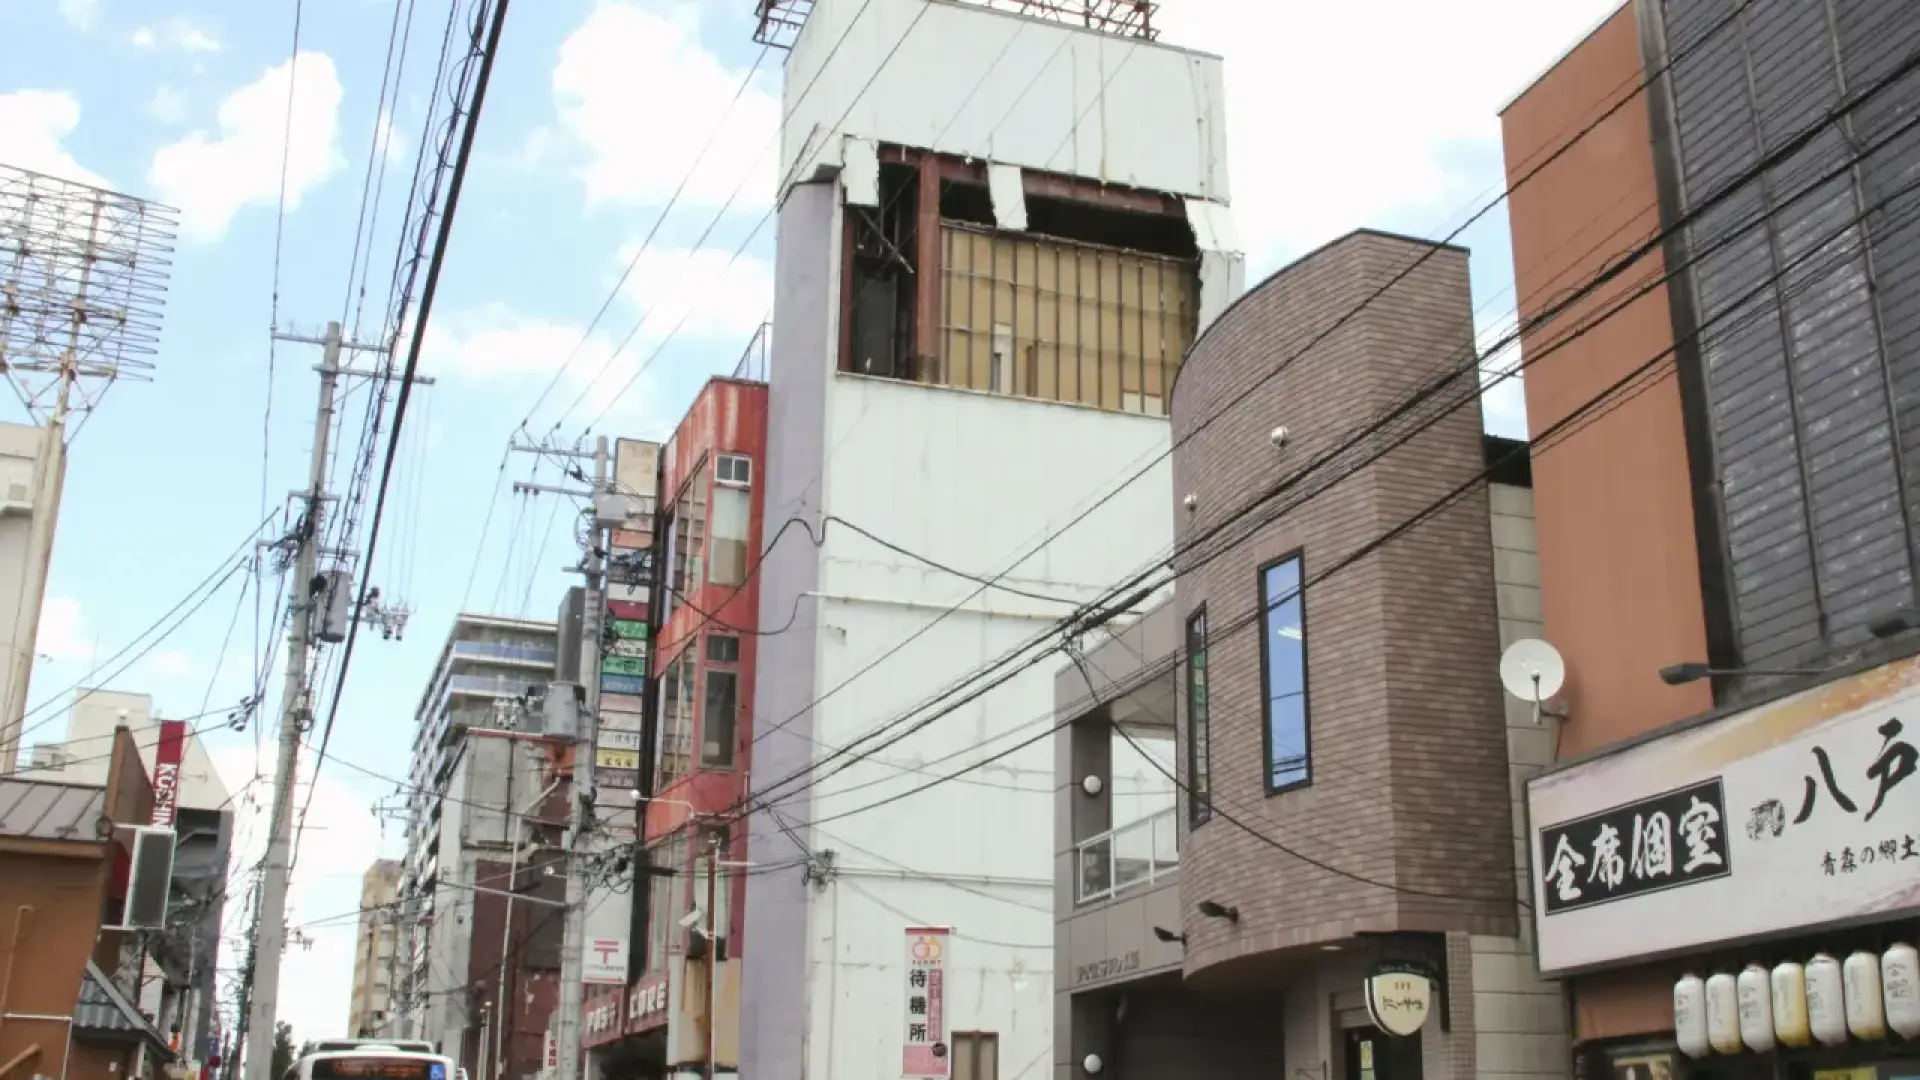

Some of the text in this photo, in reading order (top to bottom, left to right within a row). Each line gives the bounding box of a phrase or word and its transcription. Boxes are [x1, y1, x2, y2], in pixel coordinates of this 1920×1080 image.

[1792, 716, 1919, 825] 八戸
[1544, 795, 1724, 901] 全席個室
[1821, 833, 1920, 877] 青森の郷土
[909, 968, 927, 1042] 待機所
